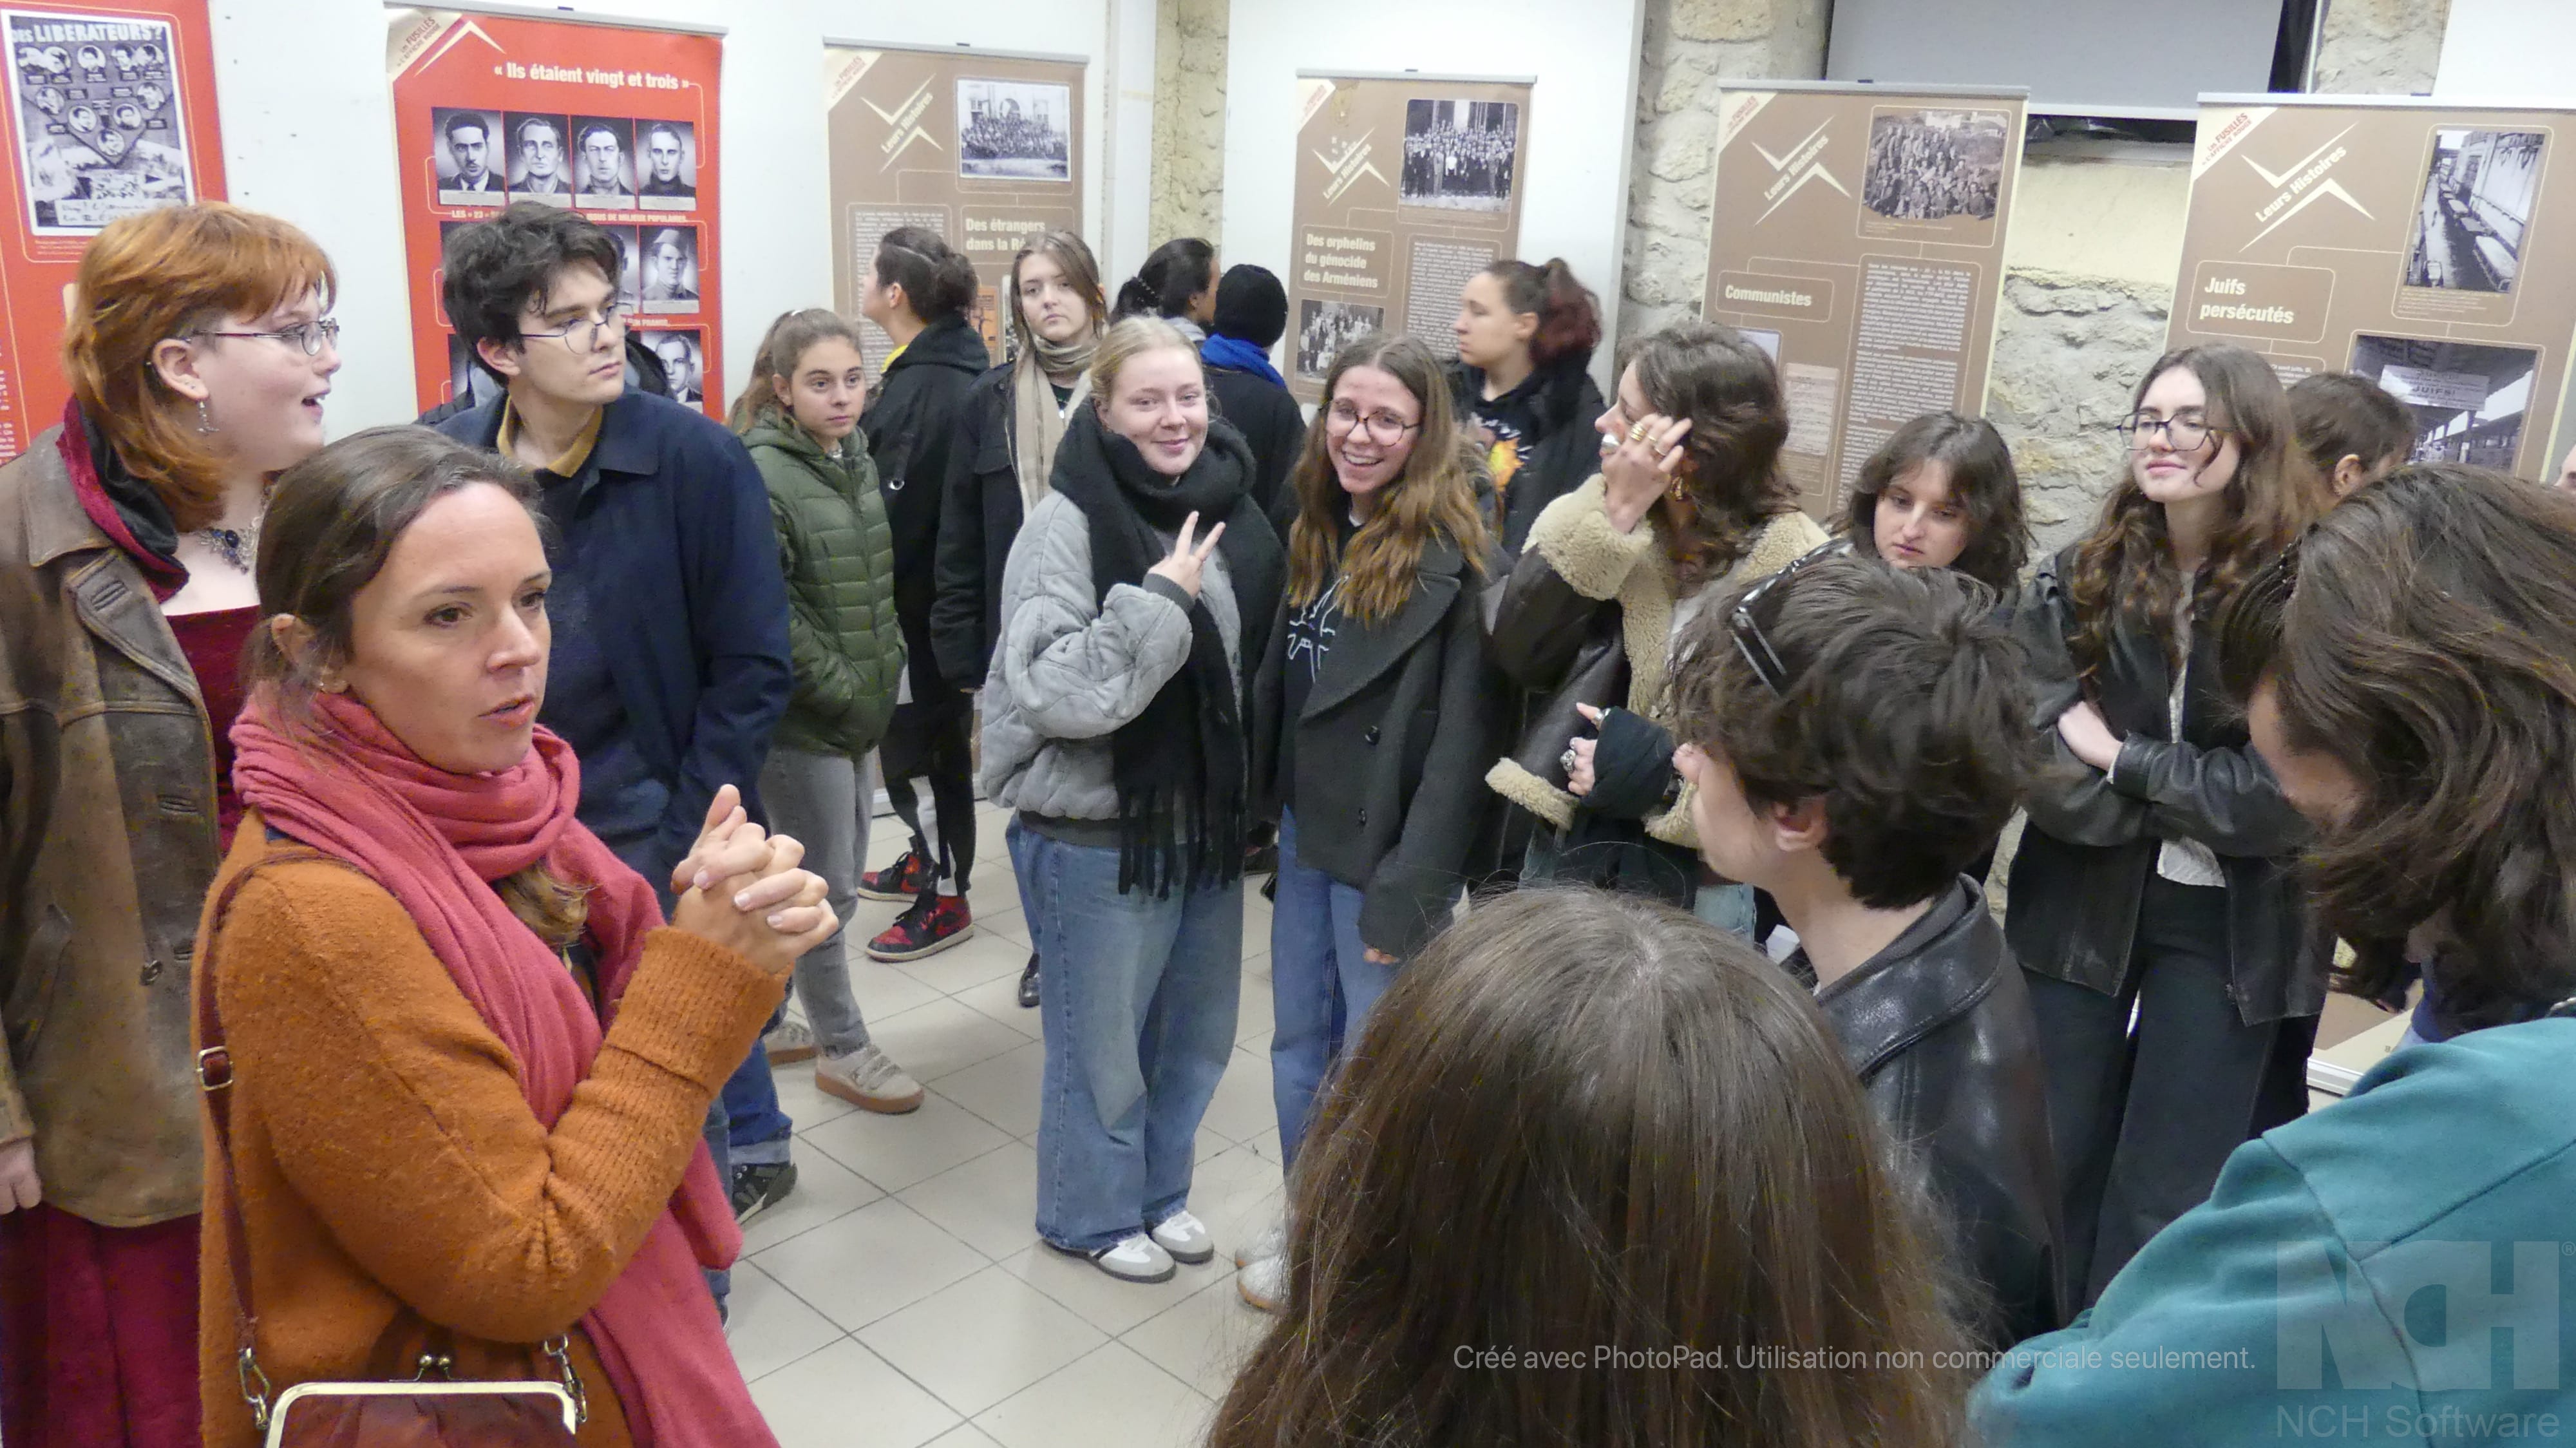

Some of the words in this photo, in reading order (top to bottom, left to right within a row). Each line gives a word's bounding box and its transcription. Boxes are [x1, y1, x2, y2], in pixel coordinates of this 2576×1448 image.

[506, 62, 526, 79] Ils
[530, 63, 583, 83] étaient
[586, 69, 624, 88] vingt
[628, 72, 642, 87] et
[646, 73, 678, 90] trois
[880, 128, 904, 153] Leurs
[901, 92, 933, 130] Histoires
[1323, 176, 1343, 198] Leurs
[1341, 144, 1371, 178] Histoires
[1764, 174, 1790, 200] Leurs
[1788, 134, 1828, 176] Histoires
[2255, 192, 2291, 222] Leurs
[2289, 146, 2347, 195] Histoires
[966, 218, 987, 231] Des
[990, 217, 1045, 234] étrangers
[966, 237, 994, 250] dans
[998, 238, 1008, 251] la
[1307, 233, 1324, 247] Des
[1327, 236, 1376, 251] orphelins
[1305, 251, 1318, 264] du
[1320, 253, 1367, 269] génocide
[1304, 269, 1320, 282] des
[1322, 271, 1378, 288] Arméniens
[2204, 277, 2246, 295] Juifs
[1725, 285, 1812, 306] Communistes
[2199, 303, 2295, 324] persécutés
